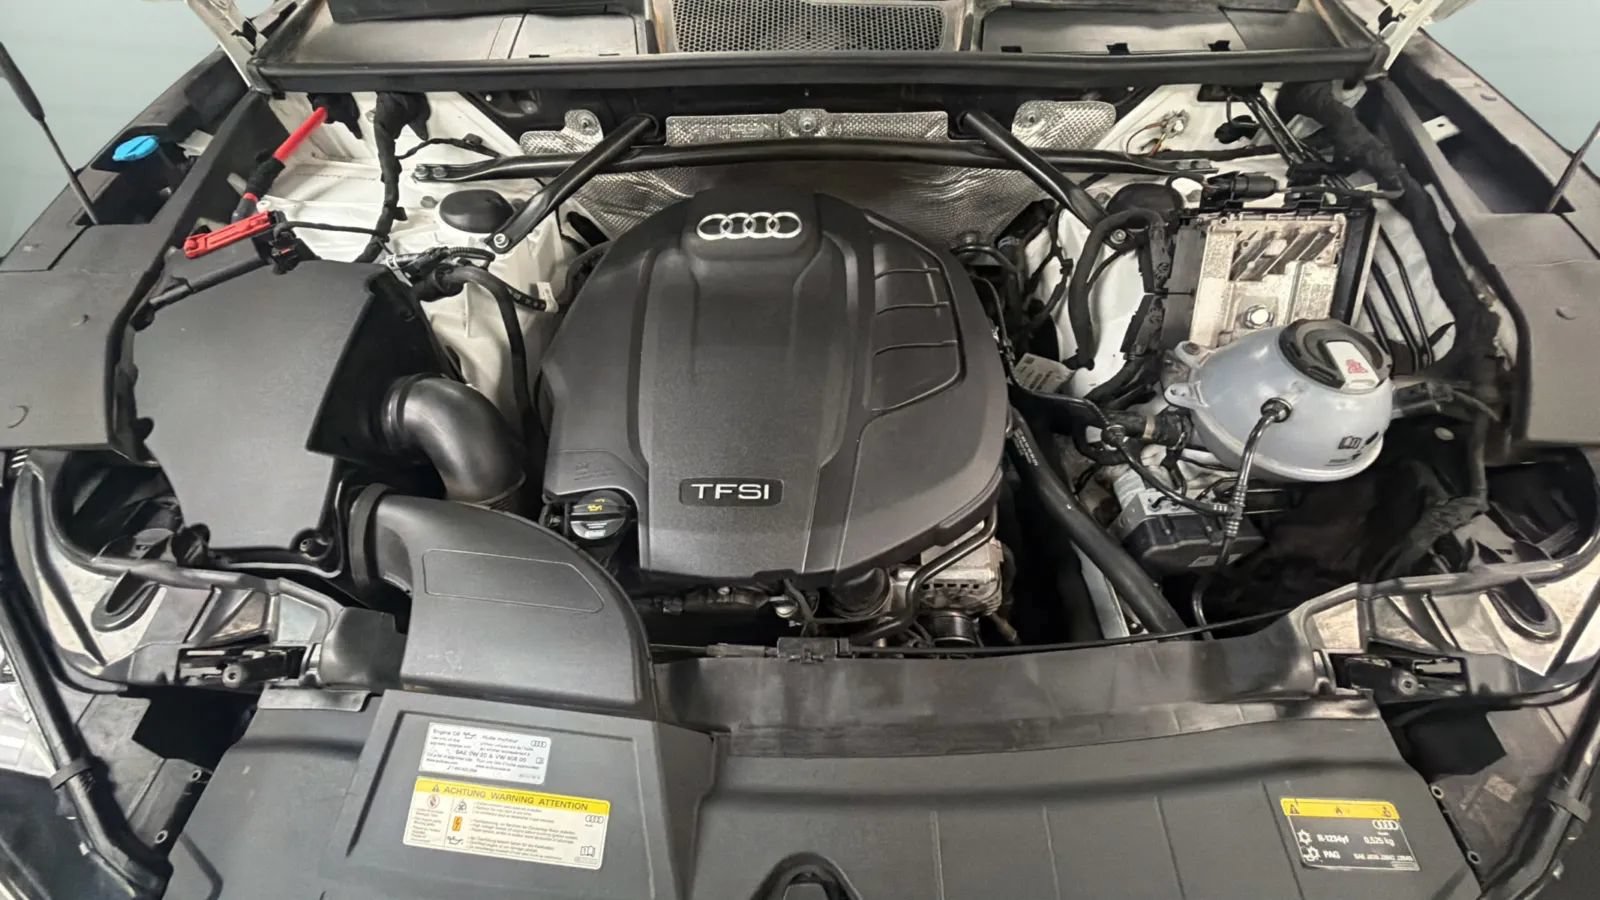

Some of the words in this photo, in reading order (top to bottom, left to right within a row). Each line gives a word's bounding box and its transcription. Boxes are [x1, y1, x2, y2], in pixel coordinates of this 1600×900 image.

[691, 484, 769, 499] TFSI
[443, 786, 486, 798] ACHTUNG
[490, 791, 534, 804] WARNING
[538, 798, 588, 811] ATTENTION
[1323, 850, 1340, 859] PAG
